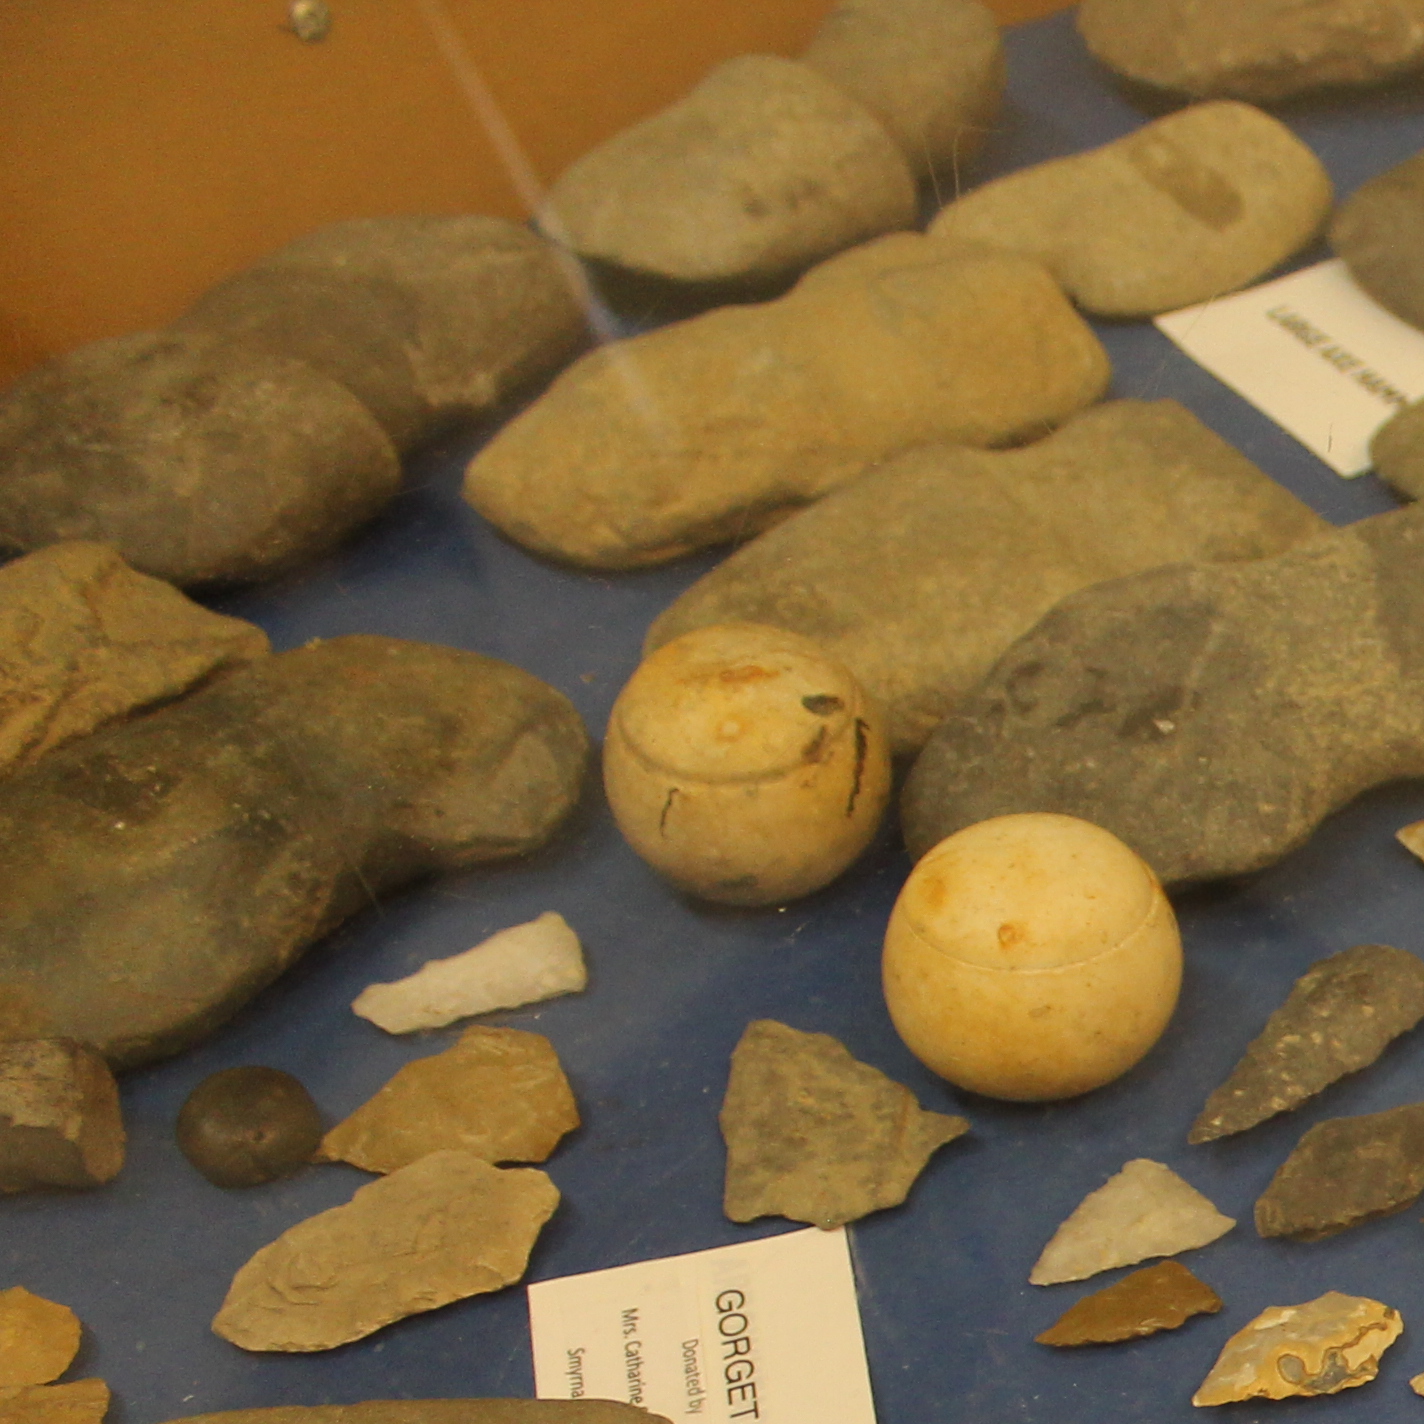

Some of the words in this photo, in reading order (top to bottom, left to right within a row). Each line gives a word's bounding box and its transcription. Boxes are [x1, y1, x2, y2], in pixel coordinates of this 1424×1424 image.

[1265, 304, 1331, 352] LARGE
[1319, 345, 1367, 378] AXE
[621, 1307, 639, 1339] Mrs.
[564, 1347, 586, 1399] Smyrna
[624, 1340, 646, 1405] Catharine
[681, 1338, 706, 1397] Donated
[715, 1288, 760, 1420] GORGET
[684, 1397, 707, 1415] by
